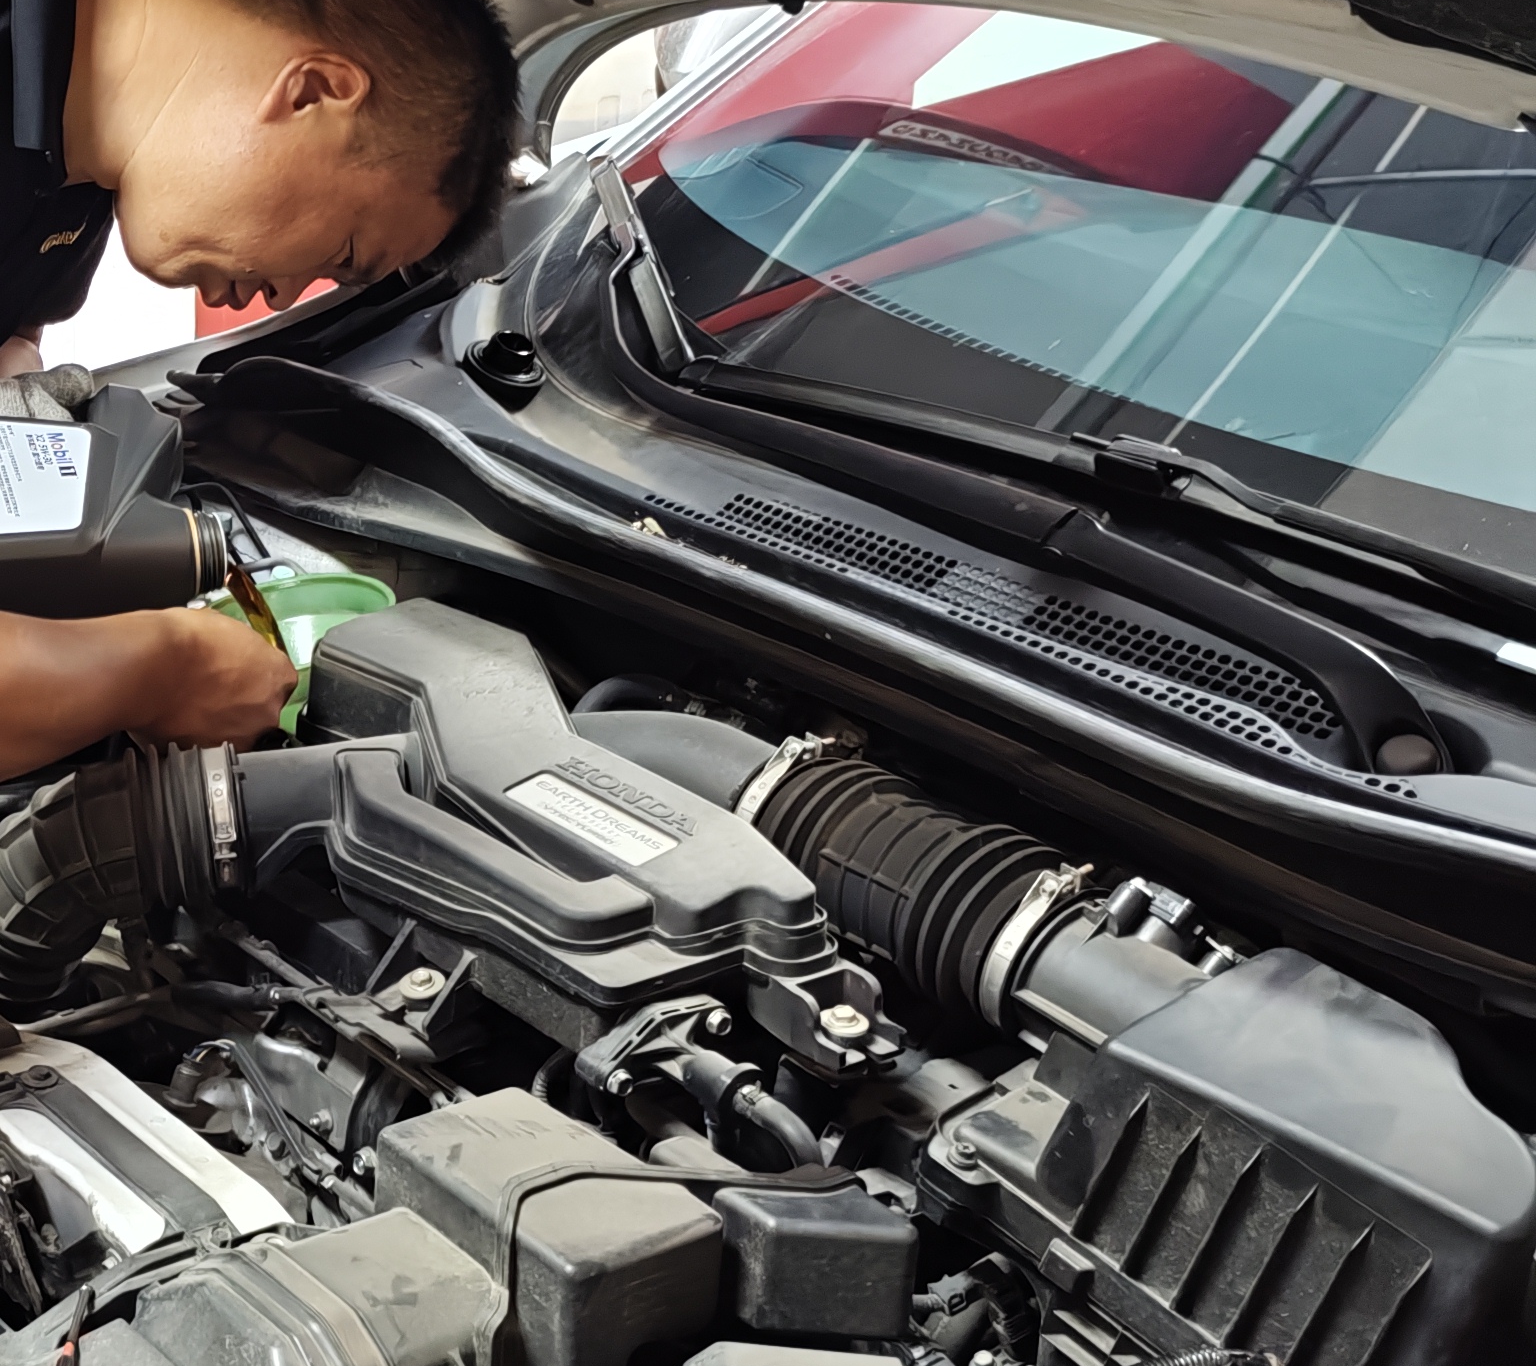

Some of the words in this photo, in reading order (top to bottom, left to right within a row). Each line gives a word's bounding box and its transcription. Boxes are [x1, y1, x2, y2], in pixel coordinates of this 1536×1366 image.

[46, 433, 73, 464] Mobil
[536, 780, 592, 813] EARTH
[590, 808, 664, 850] DREAMS
[555, 756, 698, 837] HONDA
